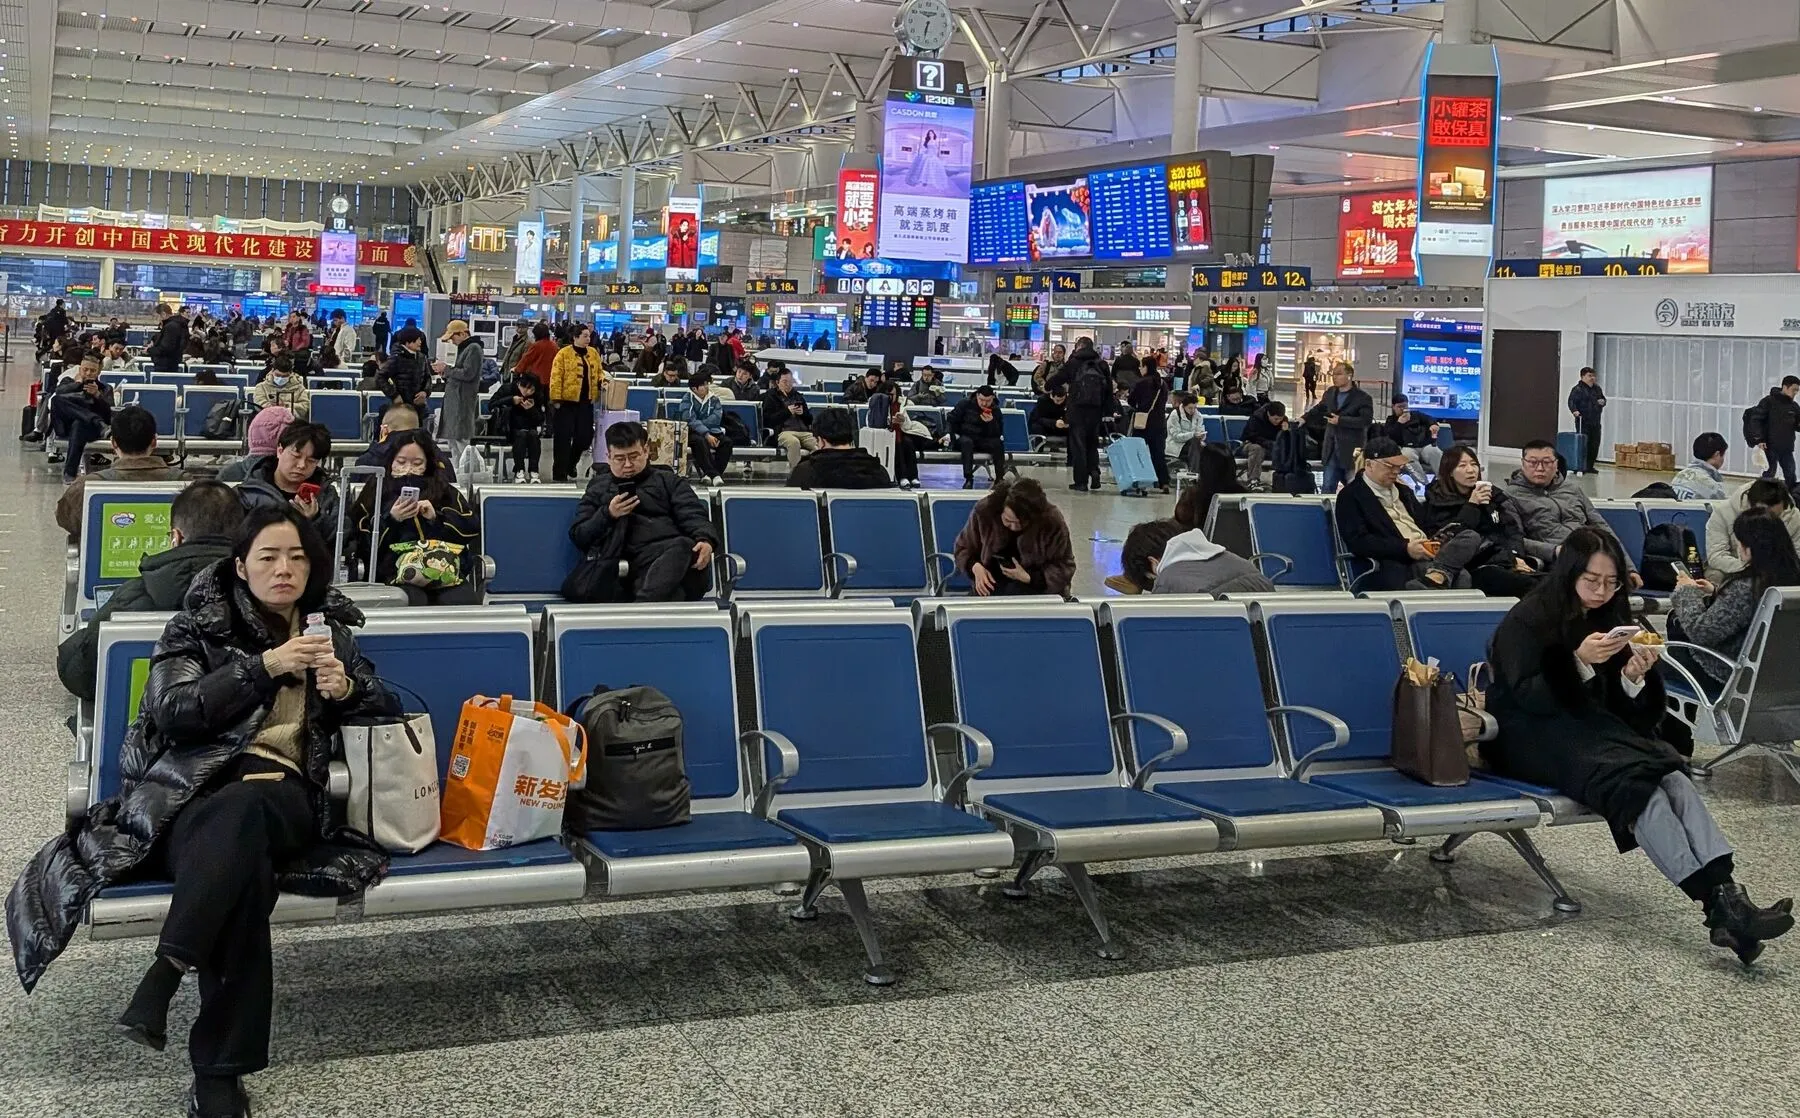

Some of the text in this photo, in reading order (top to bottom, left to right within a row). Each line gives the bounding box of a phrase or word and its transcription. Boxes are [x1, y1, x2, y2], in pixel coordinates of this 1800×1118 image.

[925, 95, 955, 105] 12306
[891, 108, 923, 117] CASDON
[1434, 100, 1486, 118] 小罐茶
[1433, 119, 1486, 137] 敢保真
[843, 208, 874, 227] 小牛
[894, 205, 957, 220] 高端蒸烤箱
[899, 219, 951, 233] 就选凯度
[1555, 264, 1581, 276] 检票口
[1058, 276, 1076, 289] 14A
[1194, 273, 1208, 286] 13A
[1262, 272, 1278, 285] 12A
[1284, 272, 1306, 286] 12A
[695, 284, 708, 292] 20A
[780, 282, 794, 291] 18A
[1303, 311, 1343, 325] HAZZYS
[520, 798, 540, 808] NEW
